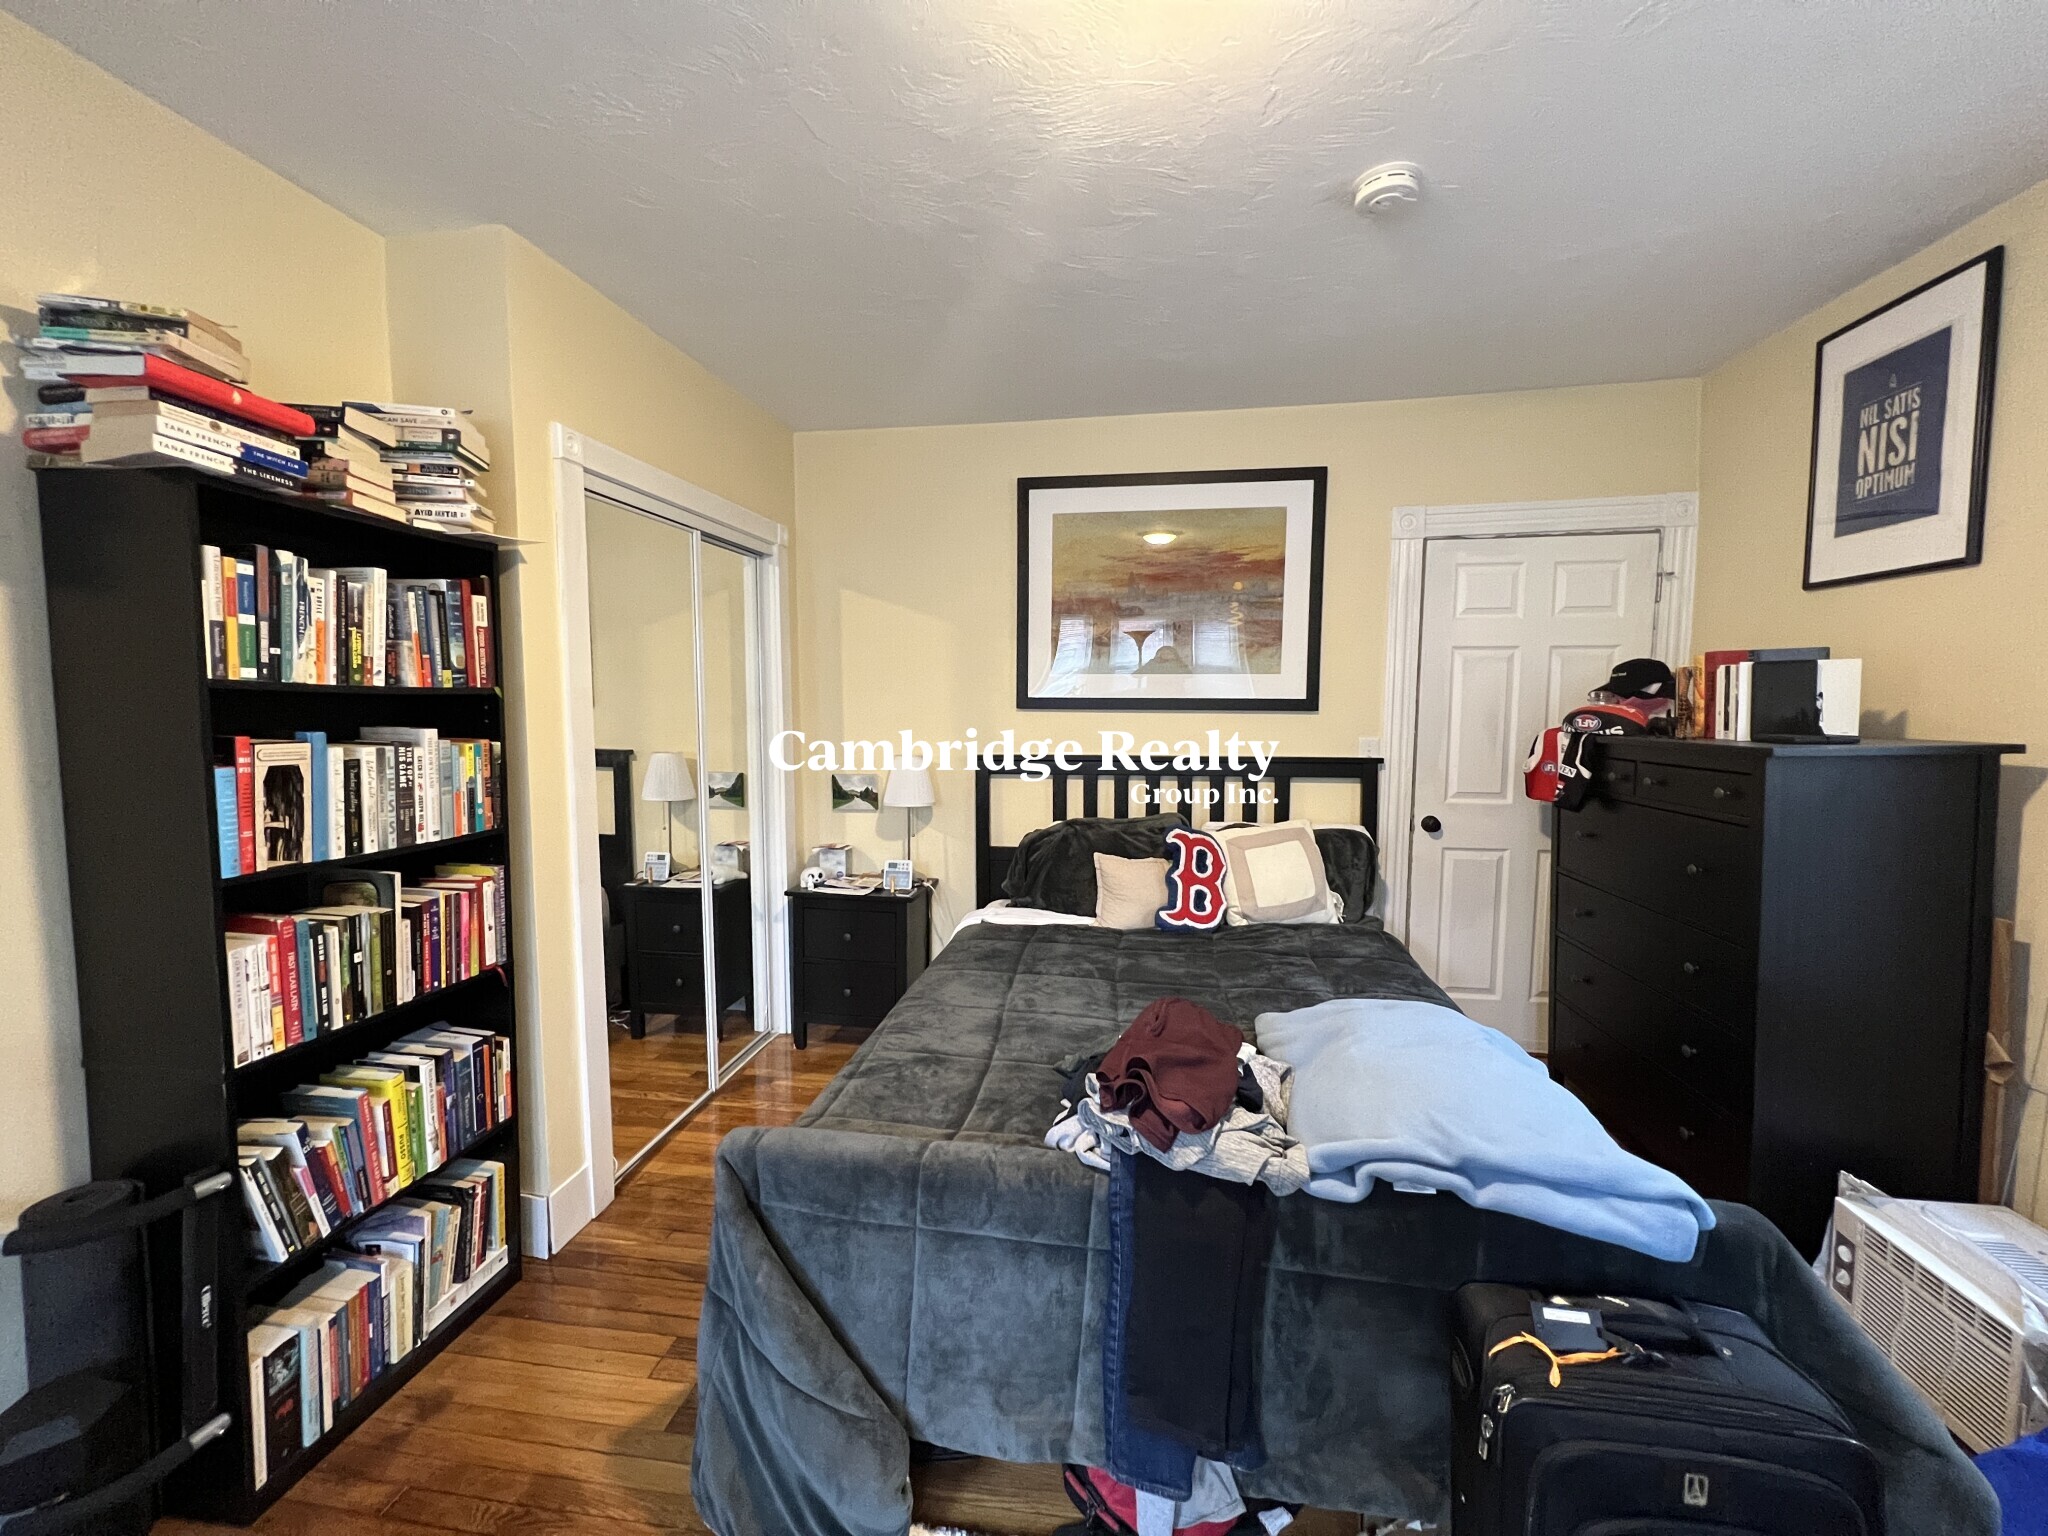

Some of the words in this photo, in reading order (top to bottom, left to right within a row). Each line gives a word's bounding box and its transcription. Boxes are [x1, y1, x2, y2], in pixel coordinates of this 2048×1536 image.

[1860, 403, 1881, 429] NIL
[1883, 386, 1921, 419] SATIS
[164, 422, 191, 436] TANA
[196, 432, 232, 449] FRENCH
[253, 451, 265, 459] THE
[266, 454, 286, 465] WITCH
[288, 461, 299, 469] ELM
[1857, 411, 1918, 477] NISI
[158, 440, 186, 455] TANA
[189, 450, 225, 466] FRENCH
[242, 466, 256, 476] THE
[259, 472, 294, 487] LIKENESS
[1855, 462, 1915, 499] OPTIMUM
[479, 647, 487, 678] DOSTOEVSKY
[1575, 718, 1599, 728] AFL
[399, 764, 407, 788] GAME
[1158, 828, 1228, 929] B
[233, 955, 243, 976] JOHN
[287, 952, 295, 969] FIRST
[235, 980, 243, 1009] IRVING
[288, 970, 297, 990] YEAR
[290, 991, 298, 1011] LATIN
[371, 1152, 380, 1179] RICHARD
